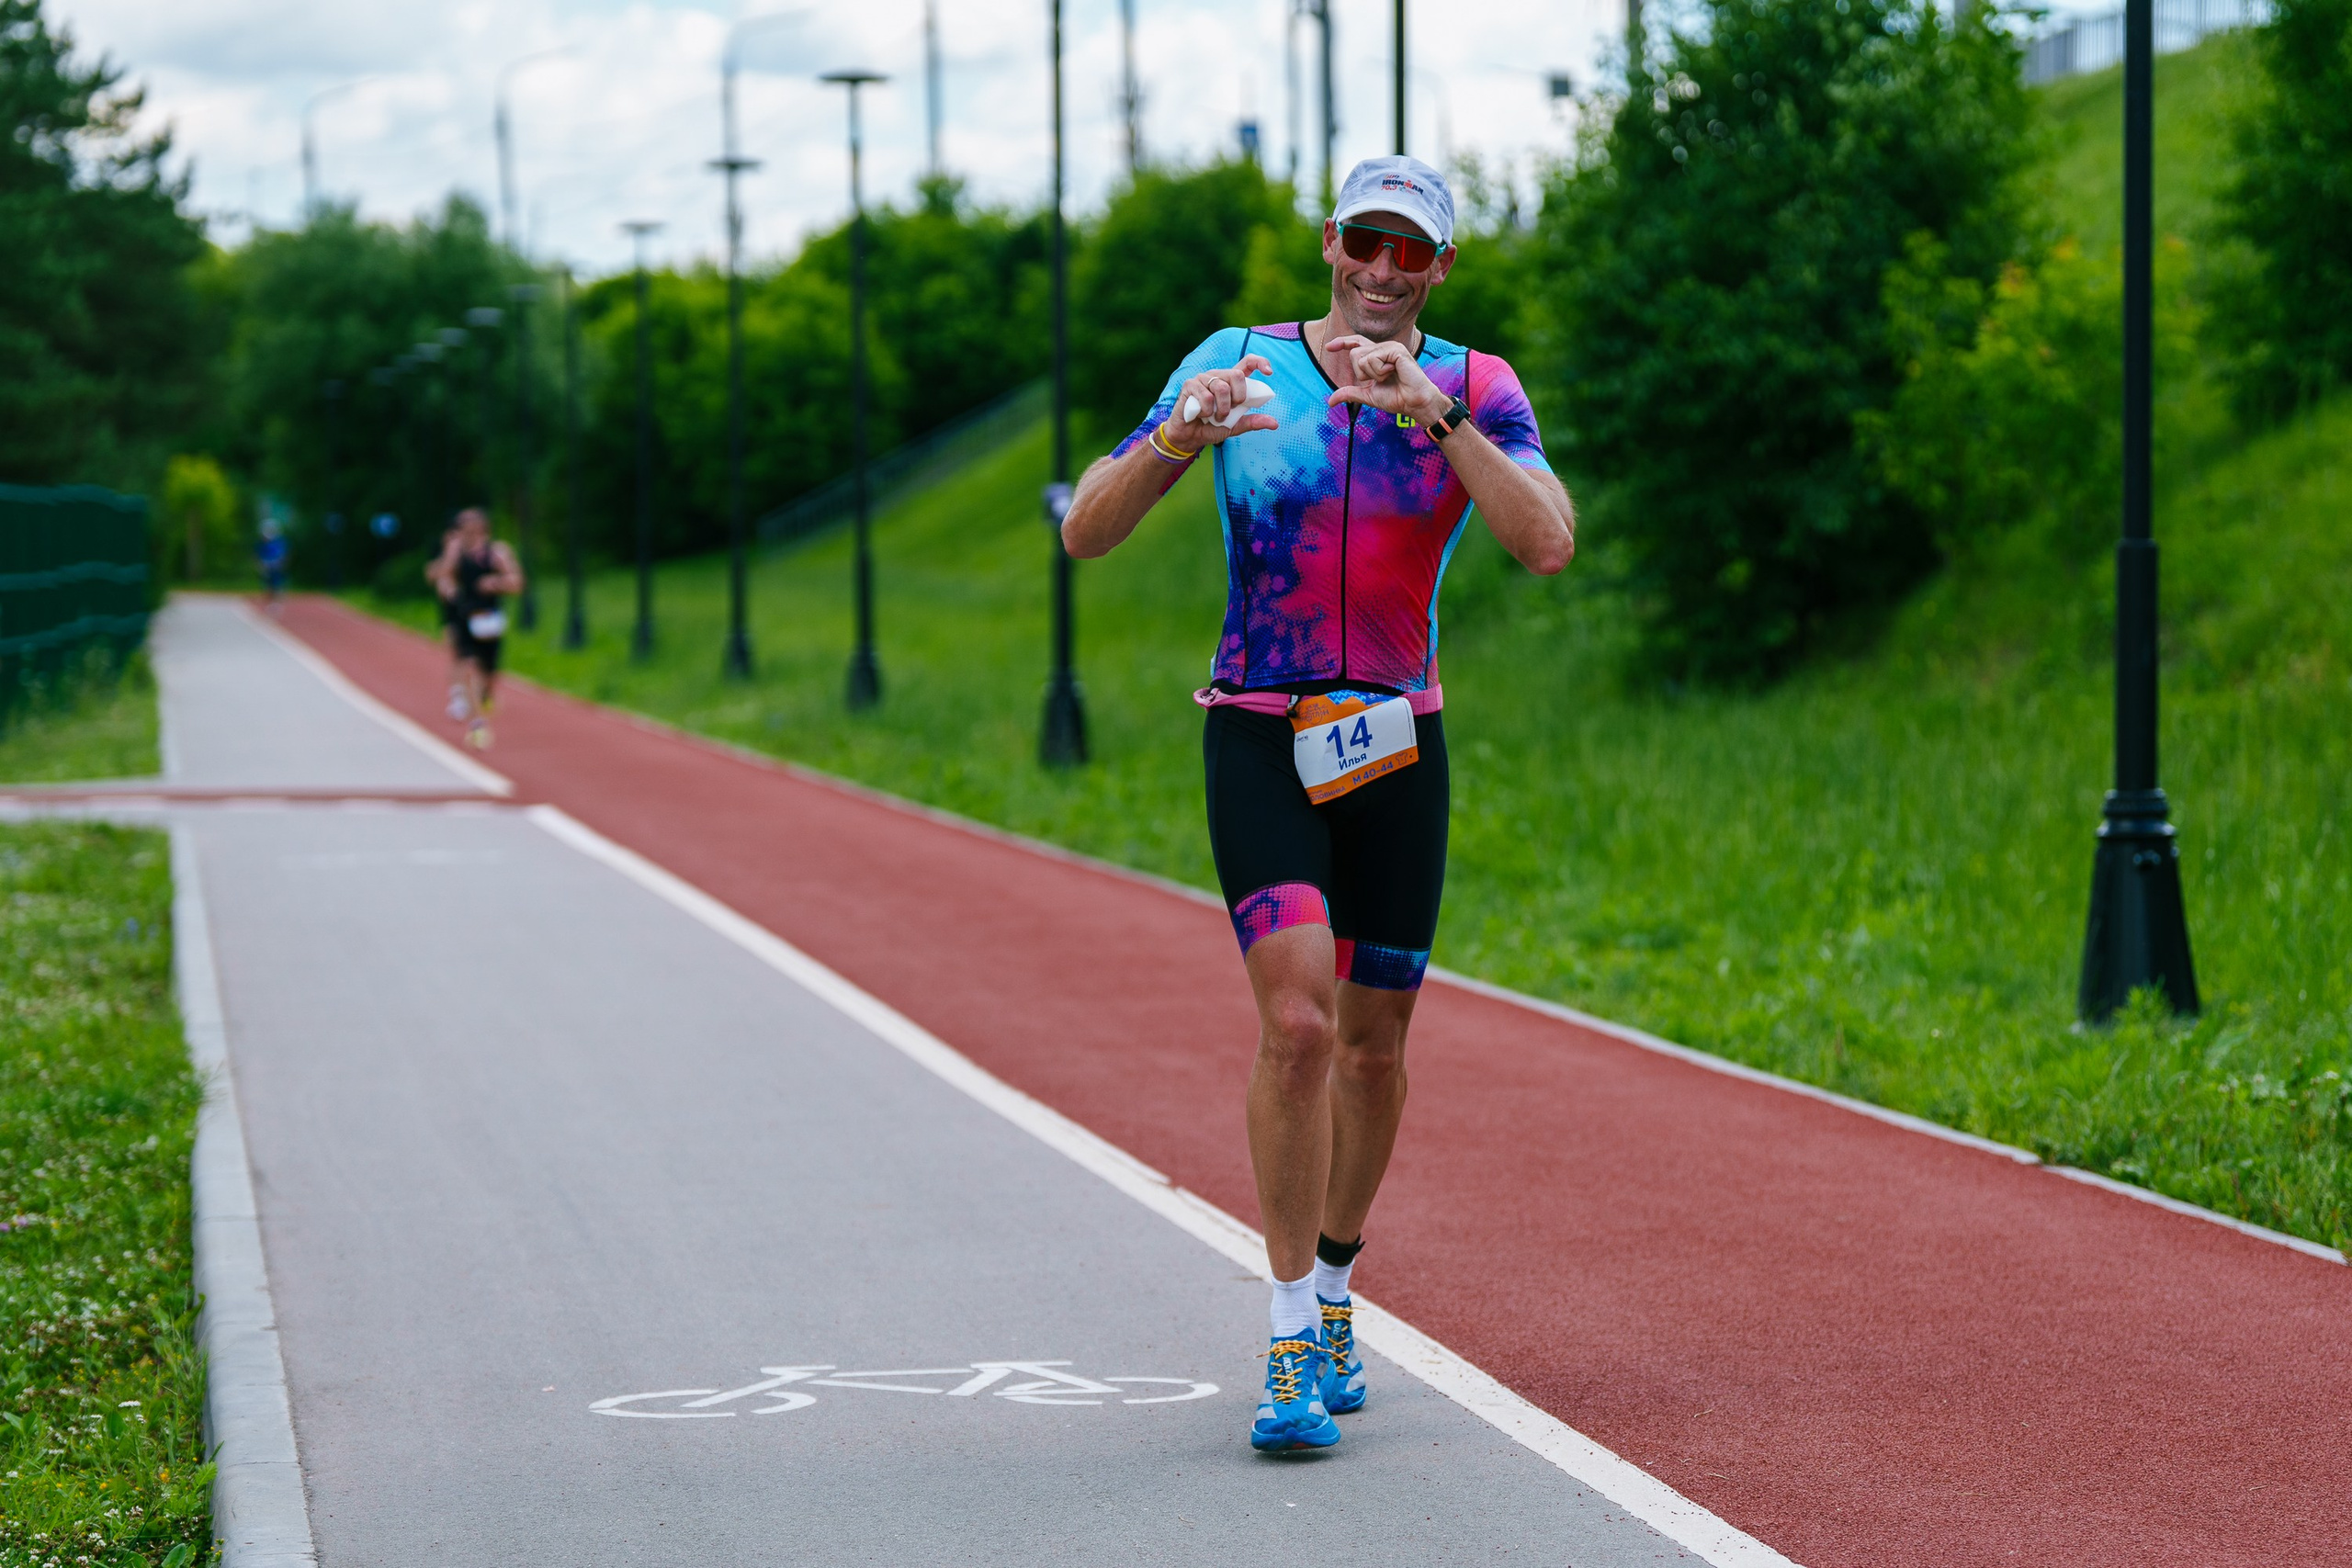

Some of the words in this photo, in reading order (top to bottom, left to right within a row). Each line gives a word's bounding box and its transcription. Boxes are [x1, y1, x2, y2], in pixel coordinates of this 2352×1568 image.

[1382, 179, 1424, 195] IRONMAN
[1326, 716, 1373, 759] 14
[1339, 753, 1367, 771] Илья
[1363, 761, 1394, 780] 40-44
[1309, 785, 1346, 802] ОЛОВИНКА
